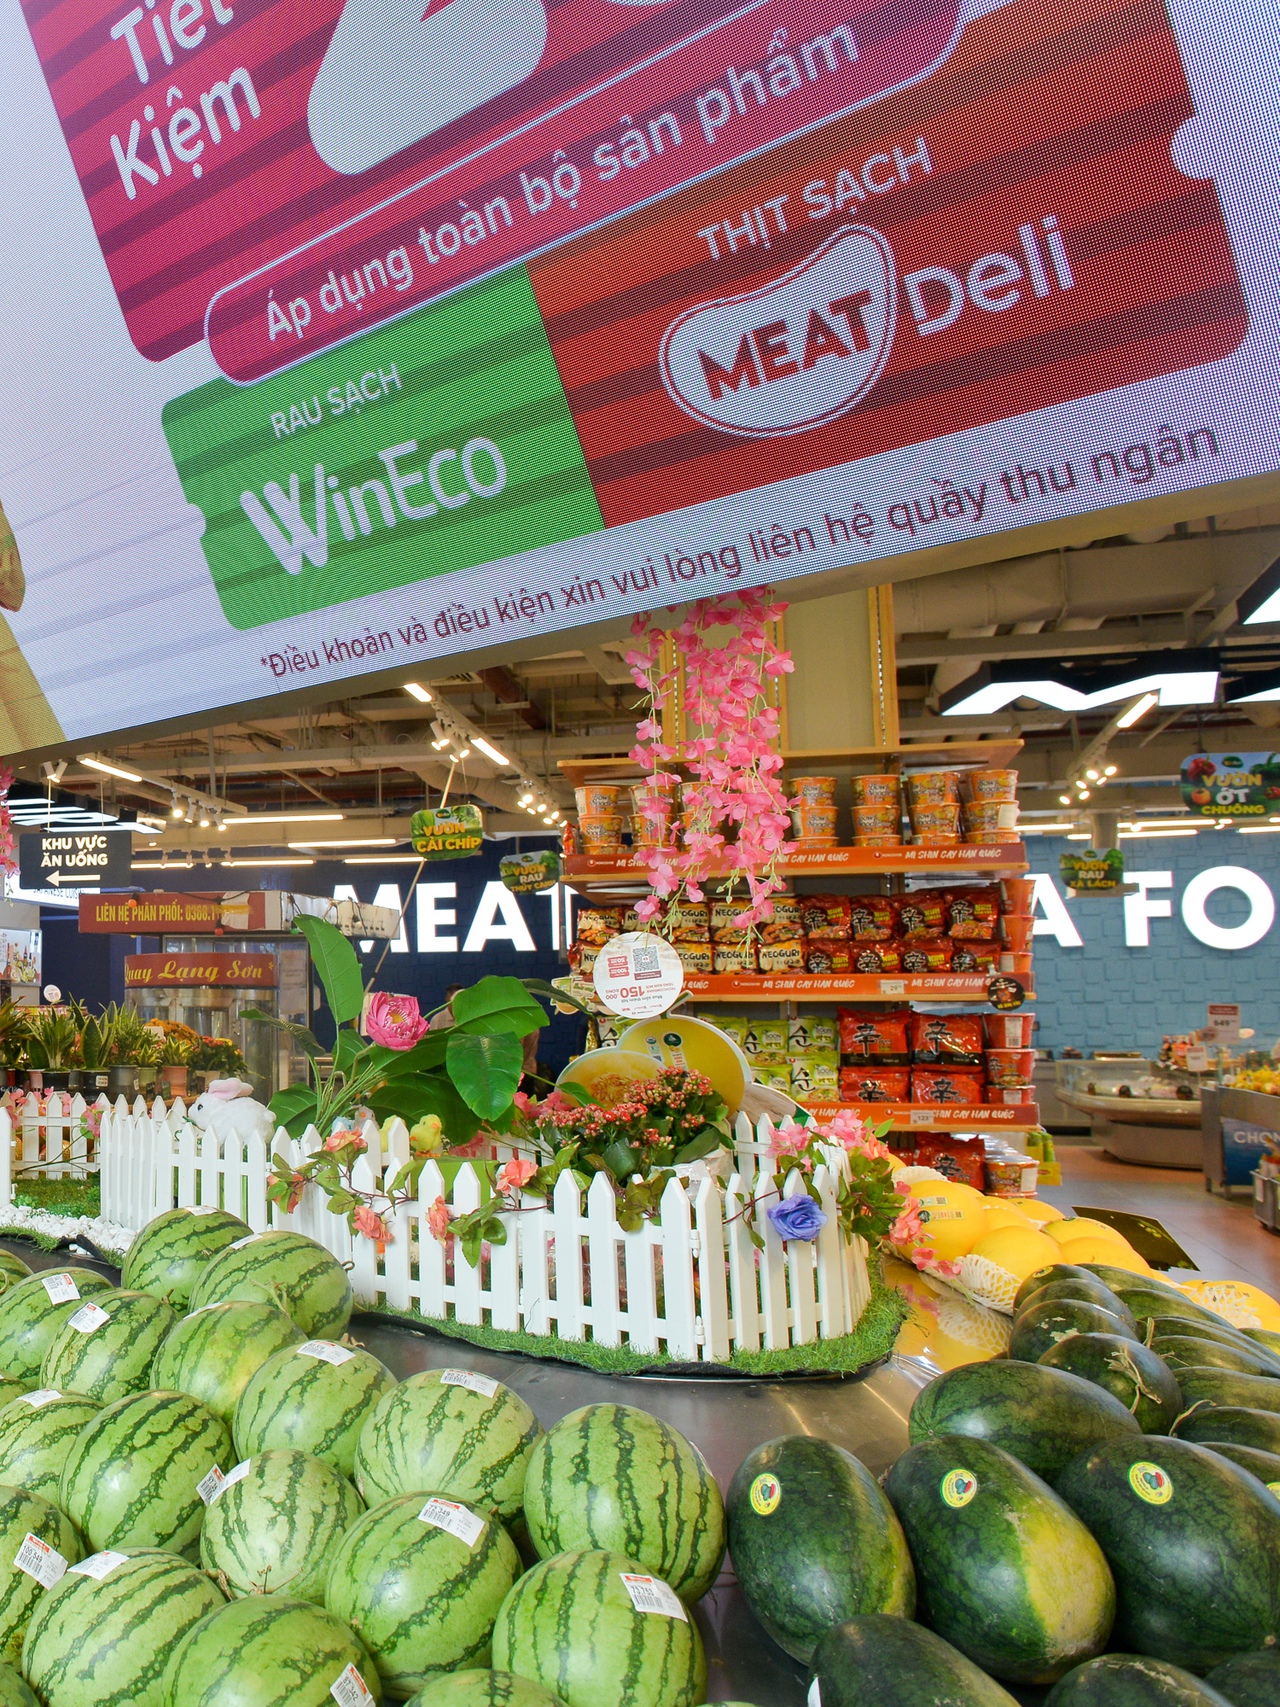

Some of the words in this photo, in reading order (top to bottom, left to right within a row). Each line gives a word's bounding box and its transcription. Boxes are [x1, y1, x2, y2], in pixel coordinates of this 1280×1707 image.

[110, 66, 261, 200] Kiệm
[266, 287, 312, 341] Áp
[319, 246, 414, 314] dụng
[417, 194, 514, 265] toàn
[521, 155, 581, 214] bộ
[594, 107, 683, 180] sản
[697, 25, 860, 144] phẩm
[697, 197, 789, 260] THỊT
[802, 135, 934, 217] SẠCH
[696, 290, 874, 401] MEAT
[903, 214, 1076, 337] Deli
[271, 396, 322, 438] RAU
[331, 364, 402, 413] SẠCH
[240, 437, 508, 576] WinEco
[325, 627, 394, 664] khoản
[397, 616, 429, 646] và
[433, 601, 491, 638] điều
[495, 588, 555, 624] kiện
[562, 574, 606, 609] xin
[611, 558, 659, 597] vui
[665, 545, 742, 582] lòng
[748, 523, 816, 564] liên
[825, 502, 876, 548] hệ
[887, 477, 989, 536] quầy
[1000, 462, 1078, 505] thu
[1092, 424, 1221, 484] ngân
[42, 837, 72, 850] KHU
[75, 834, 107, 852] VỰC
[445, 835, 482, 850] CHÍP
[40, 852, 62, 867] ĂN
[65, 849, 108, 867] UỐNG
[791, 853, 807, 863] CAY
[917, 850, 939, 859] SHIN
[941, 850, 958, 859] CAY
[519, 873, 543, 883] RAU
[1078, 870, 1105, 880] RAU
[96, 903, 116, 922] LIÊN
[118, 904, 129, 925] HỆ
[131, 903, 157, 922] PHÂN
[159, 898, 183, 922] PHỐI:
[679, 952, 710, 961] EOGURI
[158, 959, 220, 982] Lạng
[226, 959, 263, 979] Sơn
[620, 985, 645, 998] 150
[775, 980, 796, 989] SHIN
[797, 980, 813, 989] CAY
[924, 978, 945, 987] SHIN
[947, 978, 963, 986] CAY
[854, 1022, 881, 1057] 辛
[953, 1109, 969, 1118] CAY
